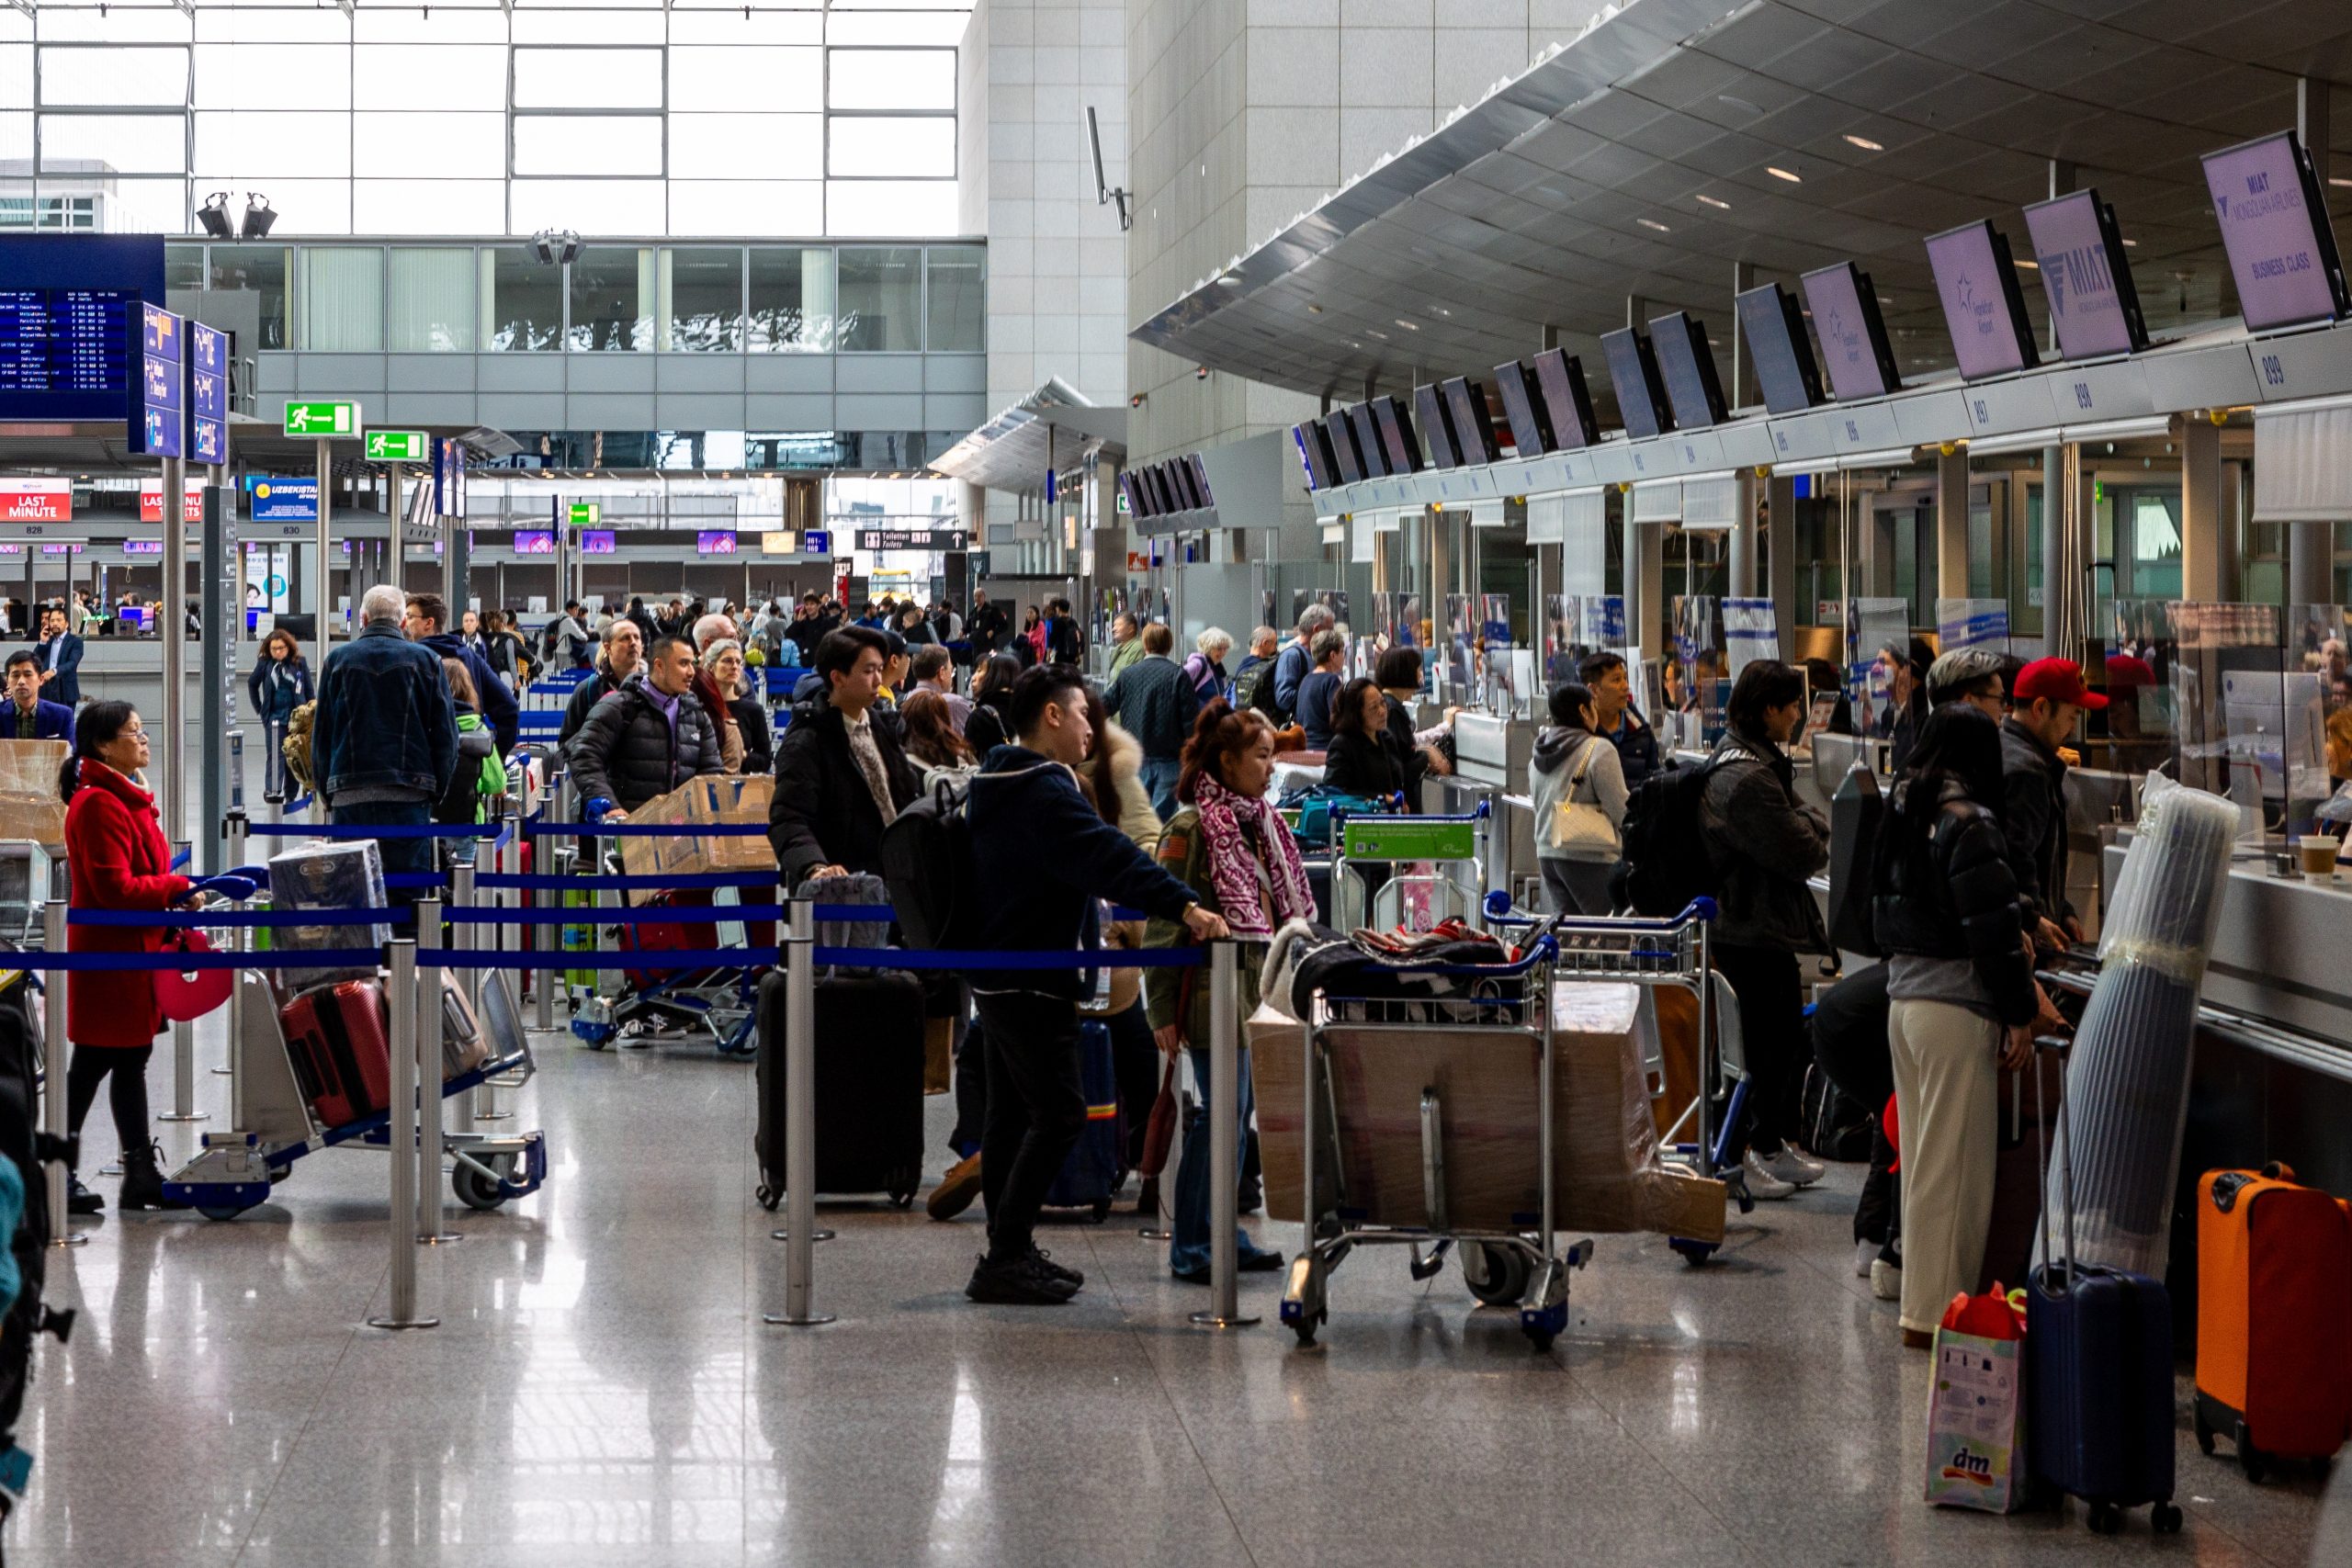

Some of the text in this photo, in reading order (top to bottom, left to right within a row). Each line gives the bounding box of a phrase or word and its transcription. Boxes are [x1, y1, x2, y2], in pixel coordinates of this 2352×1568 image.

[2246, 172, 2269, 195] MIAT
[2064, 243, 2111, 296] MIAT
[2252, 251, 2311, 279] BUSINESS CLASS
[2261, 355, 2285, 386] 899
[2074, 382, 2093, 410] 898
[1973, 400, 1990, 425] 897
[271, 486, 318, 494] UZBEKISTA
[18, 496, 47, 507] LAST
[143, 496, 163, 506] LAS
[8, 506, 57, 517] MINUTE
[26, 526, 42, 535] 828
[283, 526, 300, 535] 830
[882, 532, 910, 541] Toiletten
[882, 541, 902, 549] Toilets
[1953, 1448, 1990, 1473] dm
